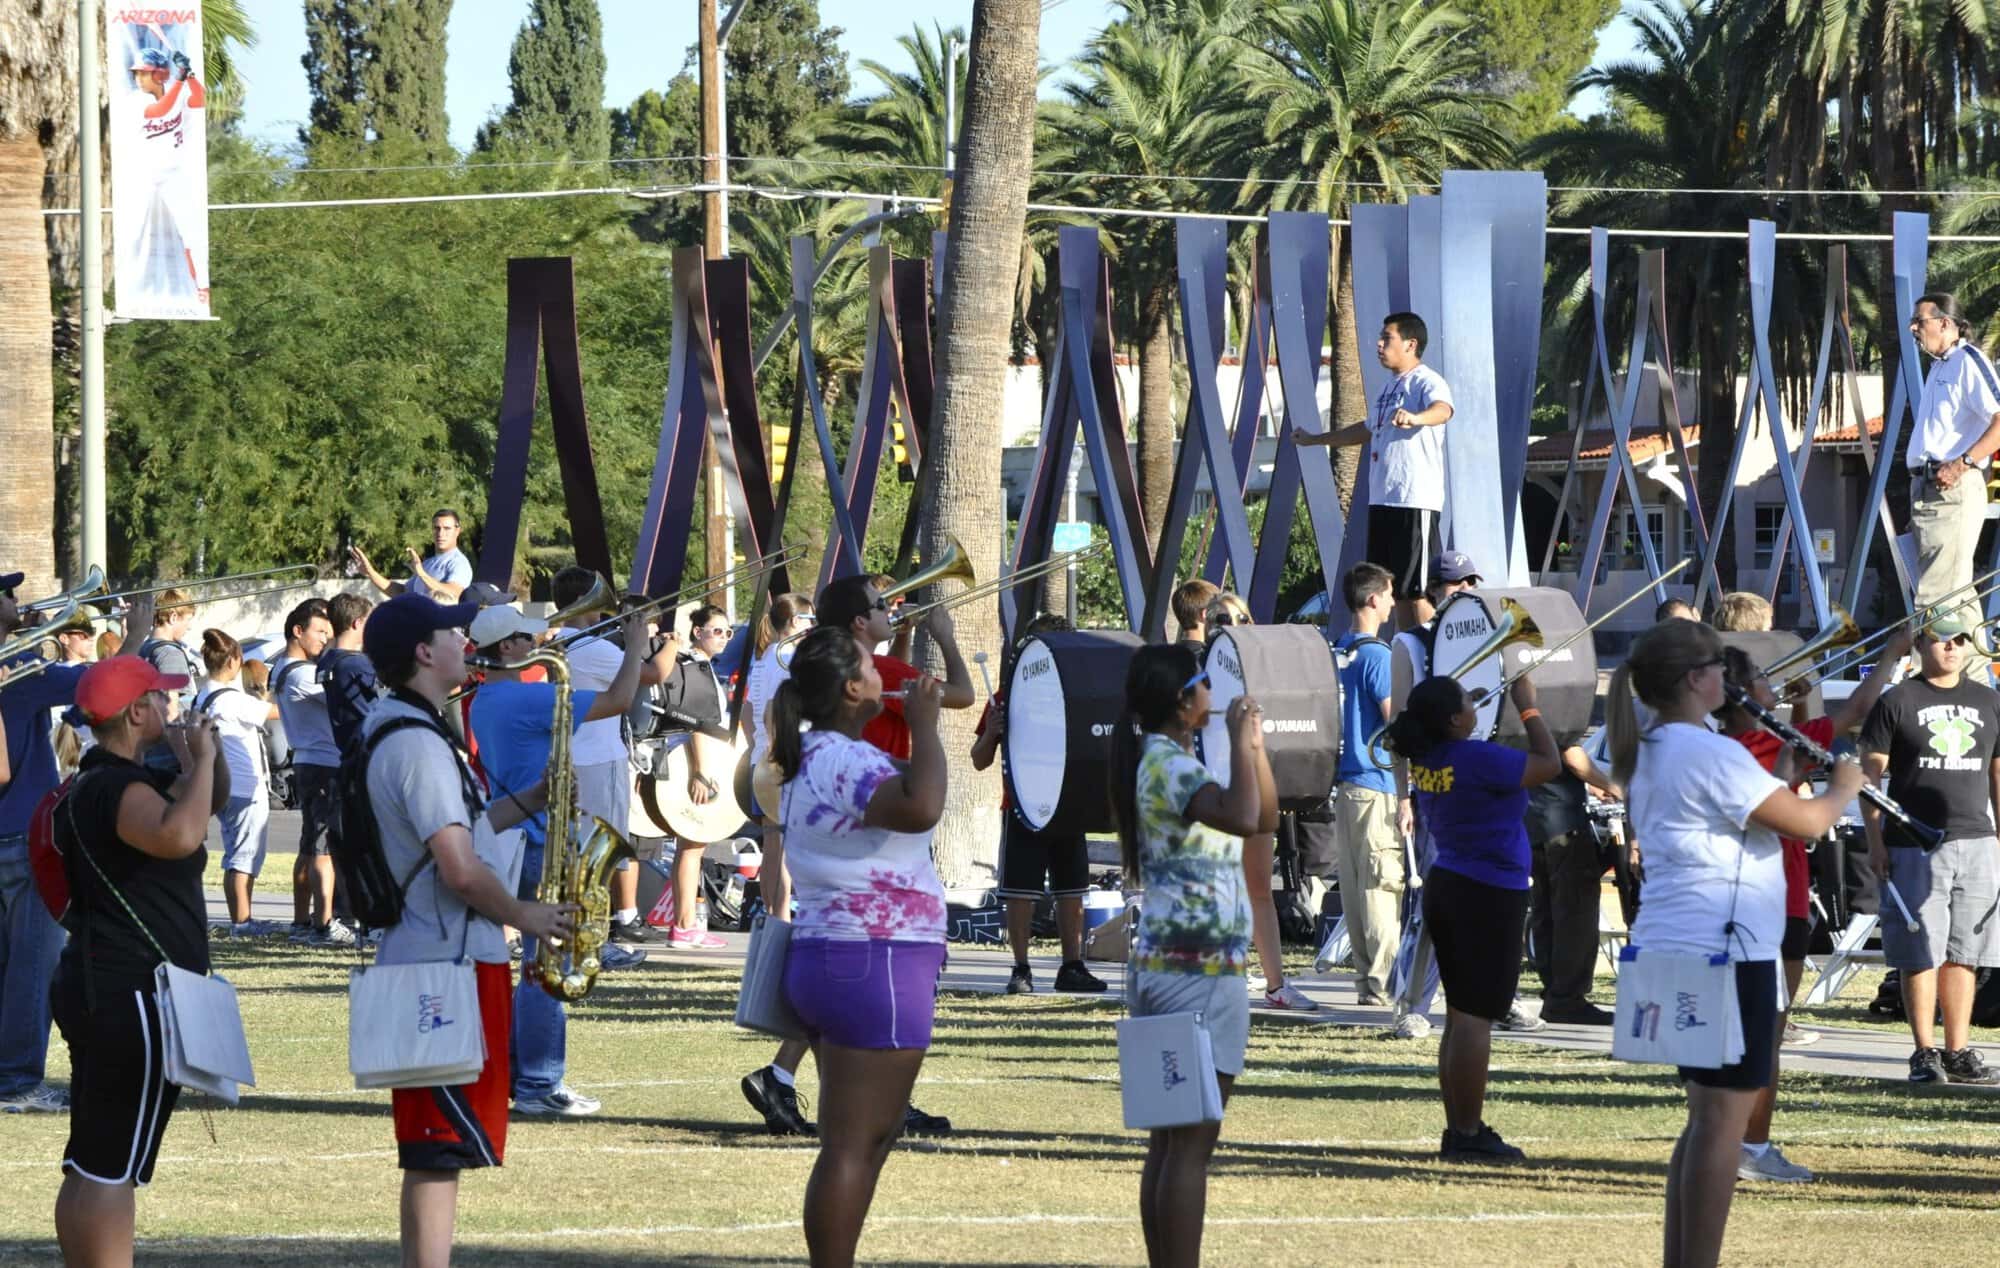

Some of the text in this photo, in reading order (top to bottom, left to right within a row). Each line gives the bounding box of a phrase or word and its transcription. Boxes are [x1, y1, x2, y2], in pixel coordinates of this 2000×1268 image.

[112, 9, 196, 25] ARIZONA
[1455, 618, 1487, 640] YAMAHA
[1029, 657, 1051, 679] YAMAHA
[1275, 719, 1317, 732] YAMAHA
[418, 993, 431, 1034] BAND
[1675, 991, 1689, 1031] BAND
